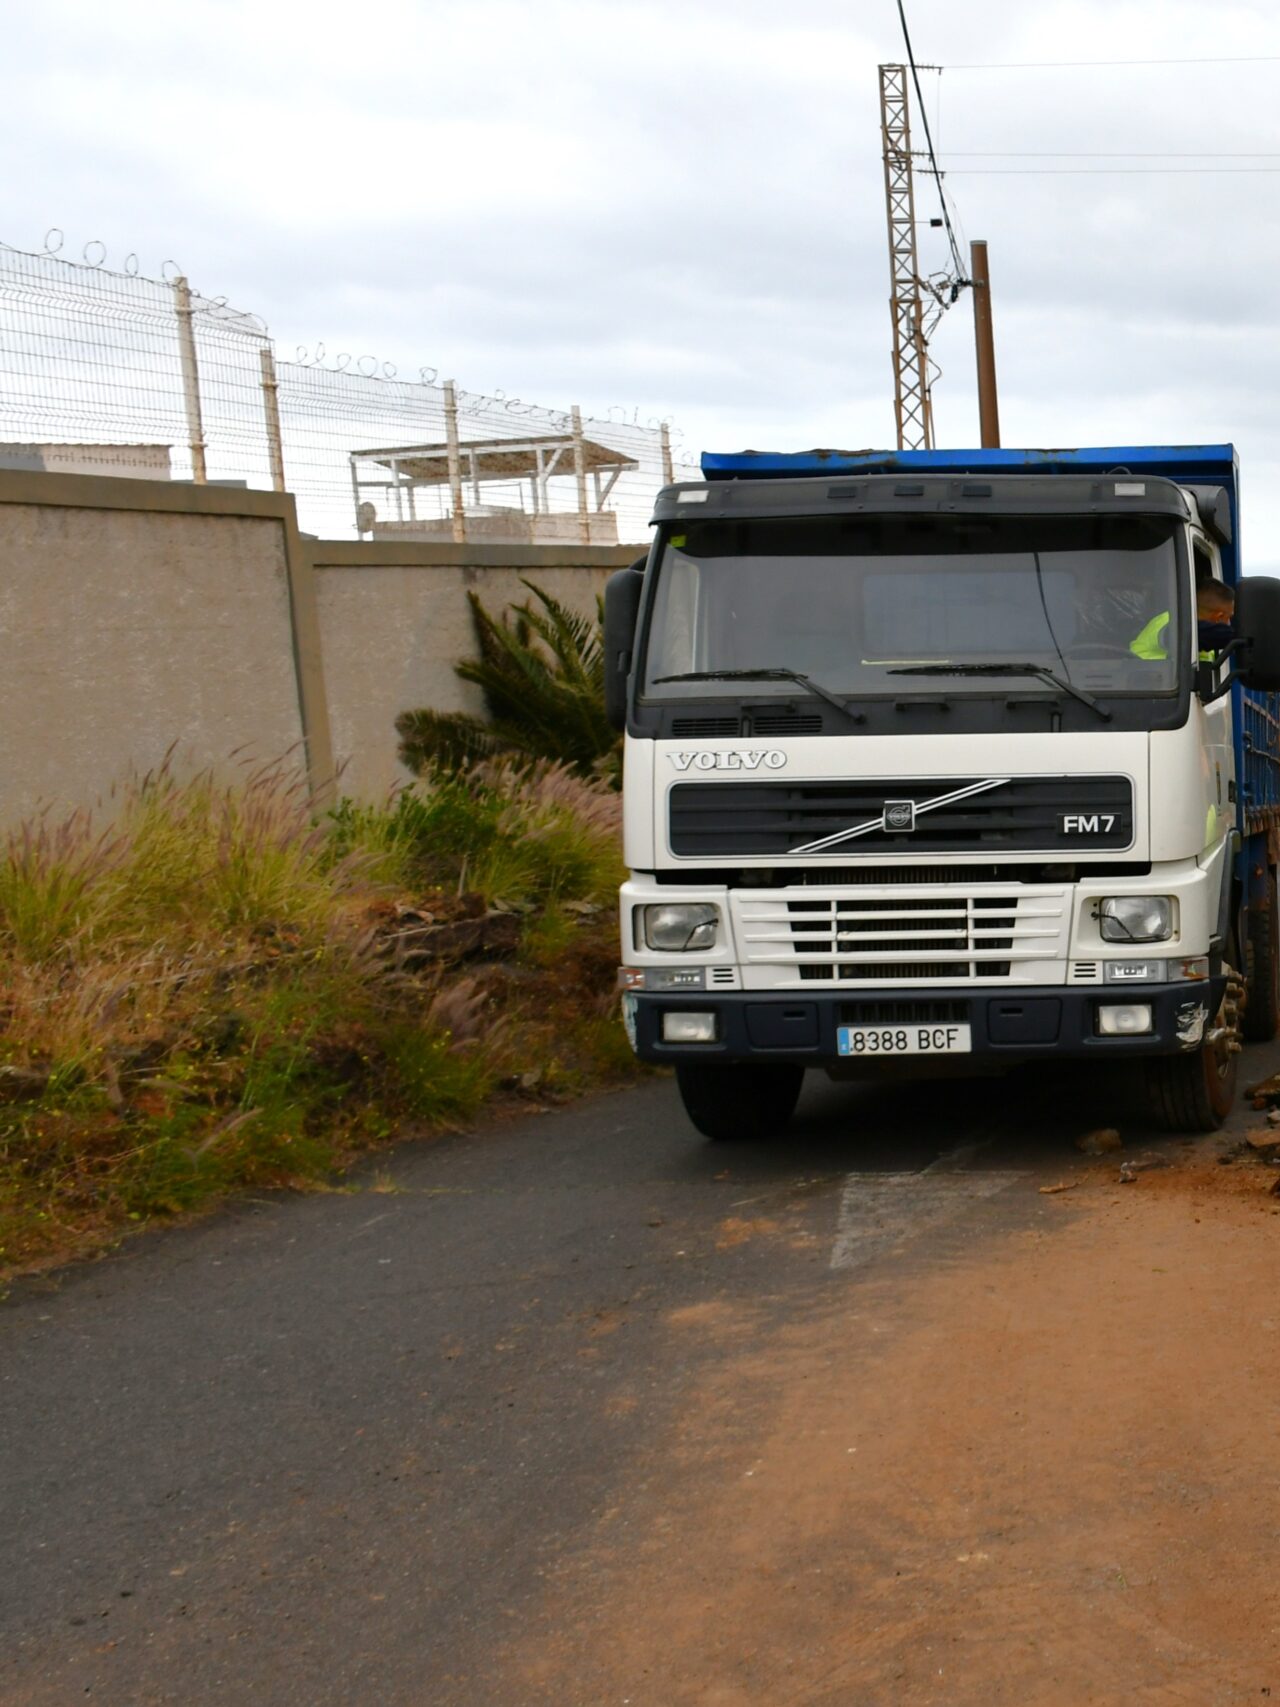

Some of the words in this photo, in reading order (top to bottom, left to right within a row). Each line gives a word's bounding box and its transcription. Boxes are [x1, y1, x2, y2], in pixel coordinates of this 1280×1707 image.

[666, 750, 788, 771] VOLVO
[852, 1030, 908, 1052] 8388
[917, 1028, 959, 1050] BCF
